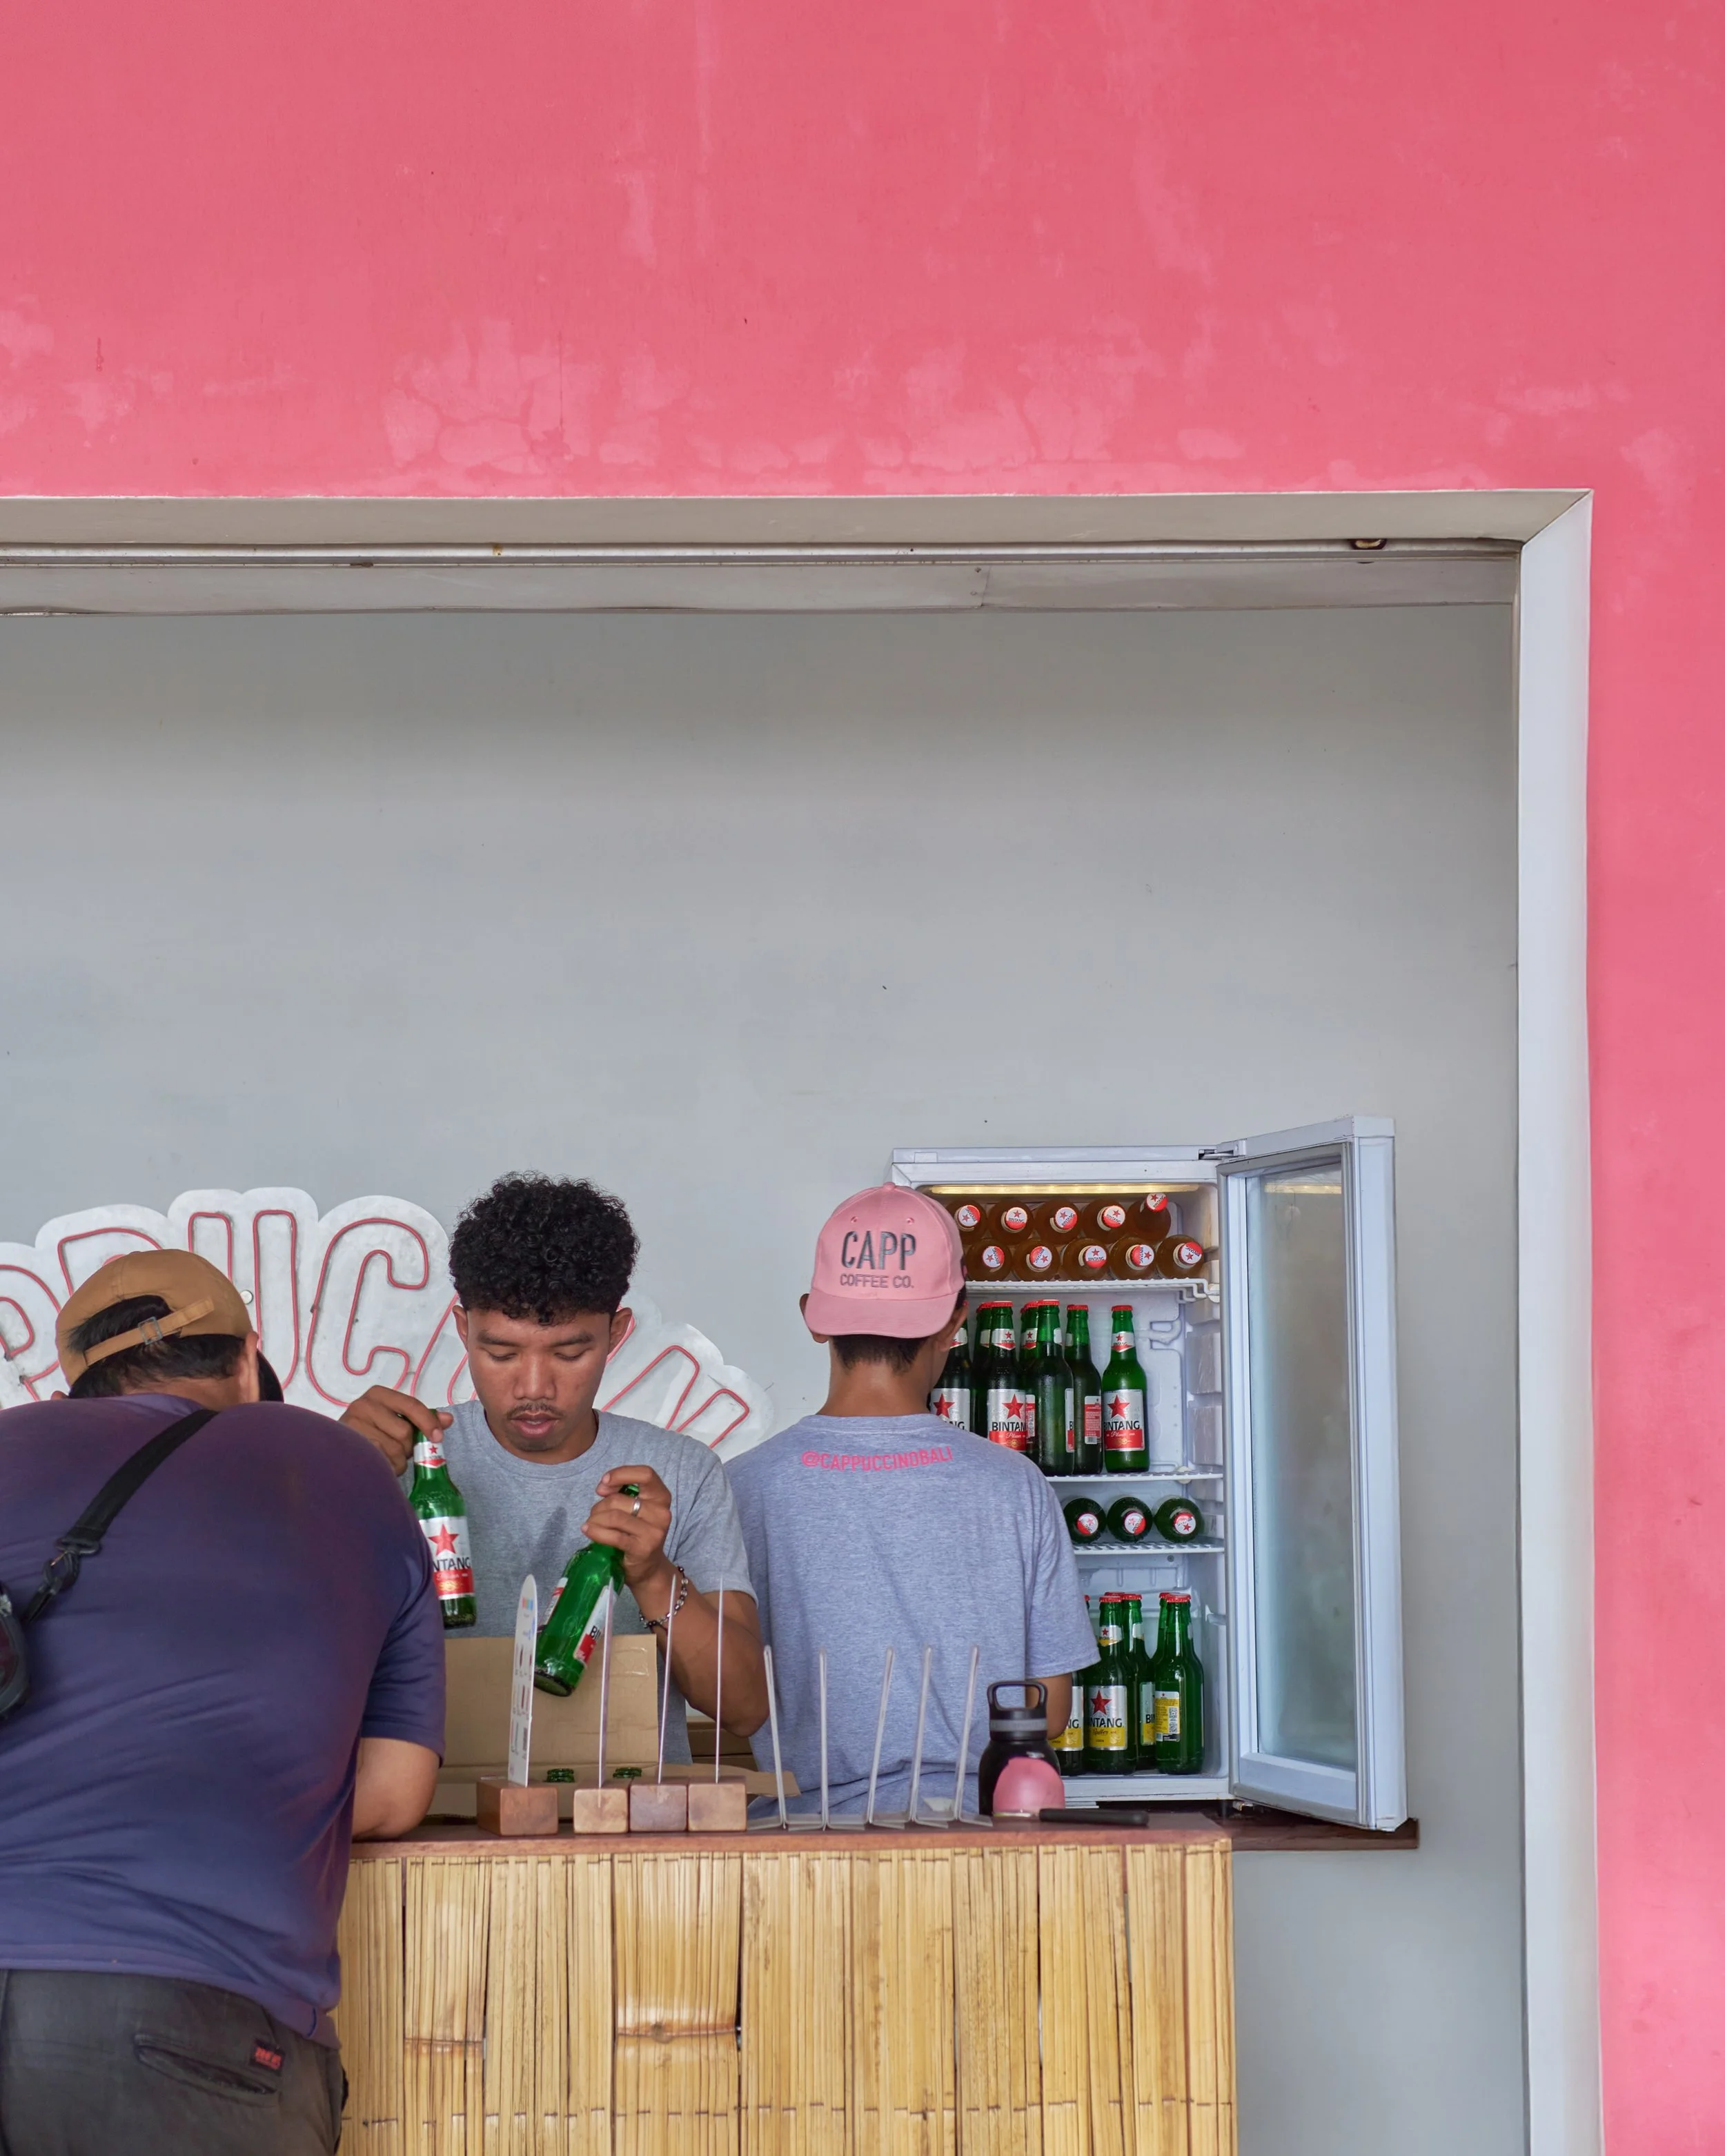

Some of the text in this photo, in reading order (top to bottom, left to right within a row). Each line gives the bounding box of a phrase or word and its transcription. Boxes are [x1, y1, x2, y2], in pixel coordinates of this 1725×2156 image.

[841, 1231, 916, 1271] CAPP
[840, 1273, 914, 1288] COFFEE CO.
[992, 1422, 1027, 1431] BINTAN
[801, 1446, 954, 1471] @CAPPUCCINOBALI
[433, 1557, 471, 1571] NTANG
[1090, 1718, 1123, 1727] NTANG
